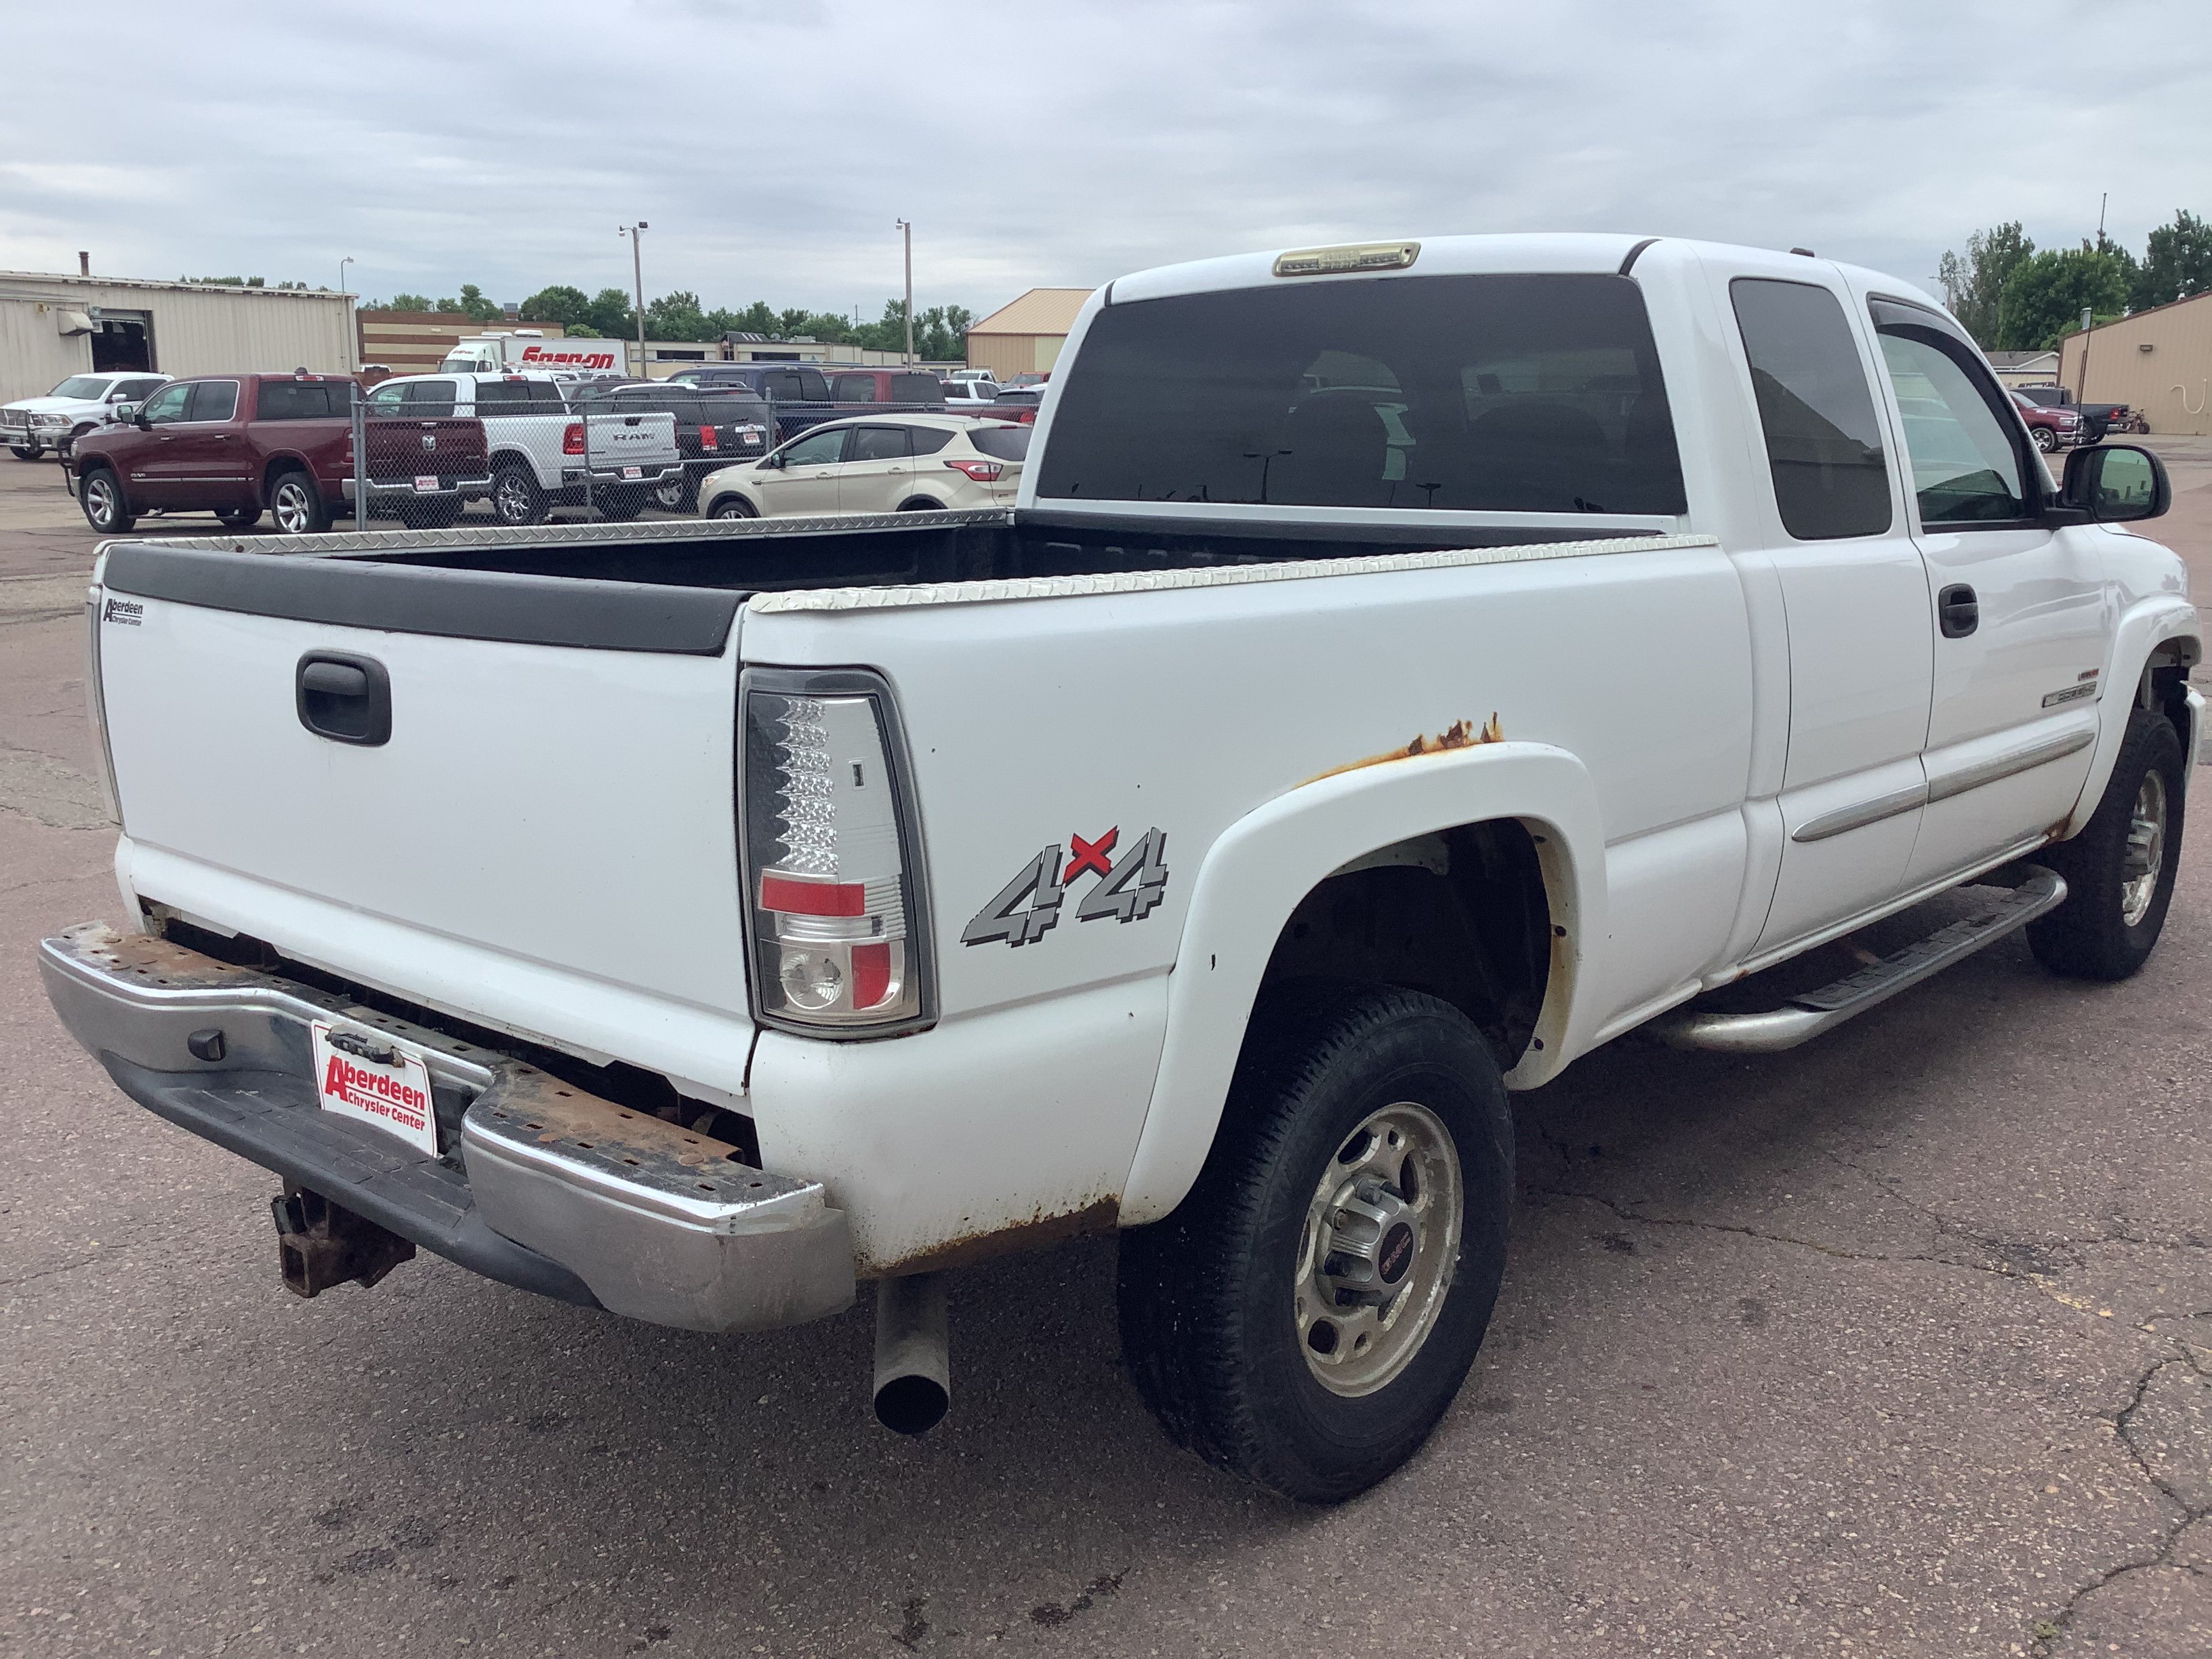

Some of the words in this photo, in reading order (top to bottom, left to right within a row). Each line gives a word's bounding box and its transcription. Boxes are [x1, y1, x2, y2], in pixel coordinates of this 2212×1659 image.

[522, 346, 615, 369] Snap-on
[103, 598, 144, 622] Aberdeen
[325, 1054, 426, 1111] Aberdeen
[348, 1091, 390, 1117] Chrysler
[391, 1107, 426, 1131] Center
[1382, 1231, 1411, 1275] GMC
